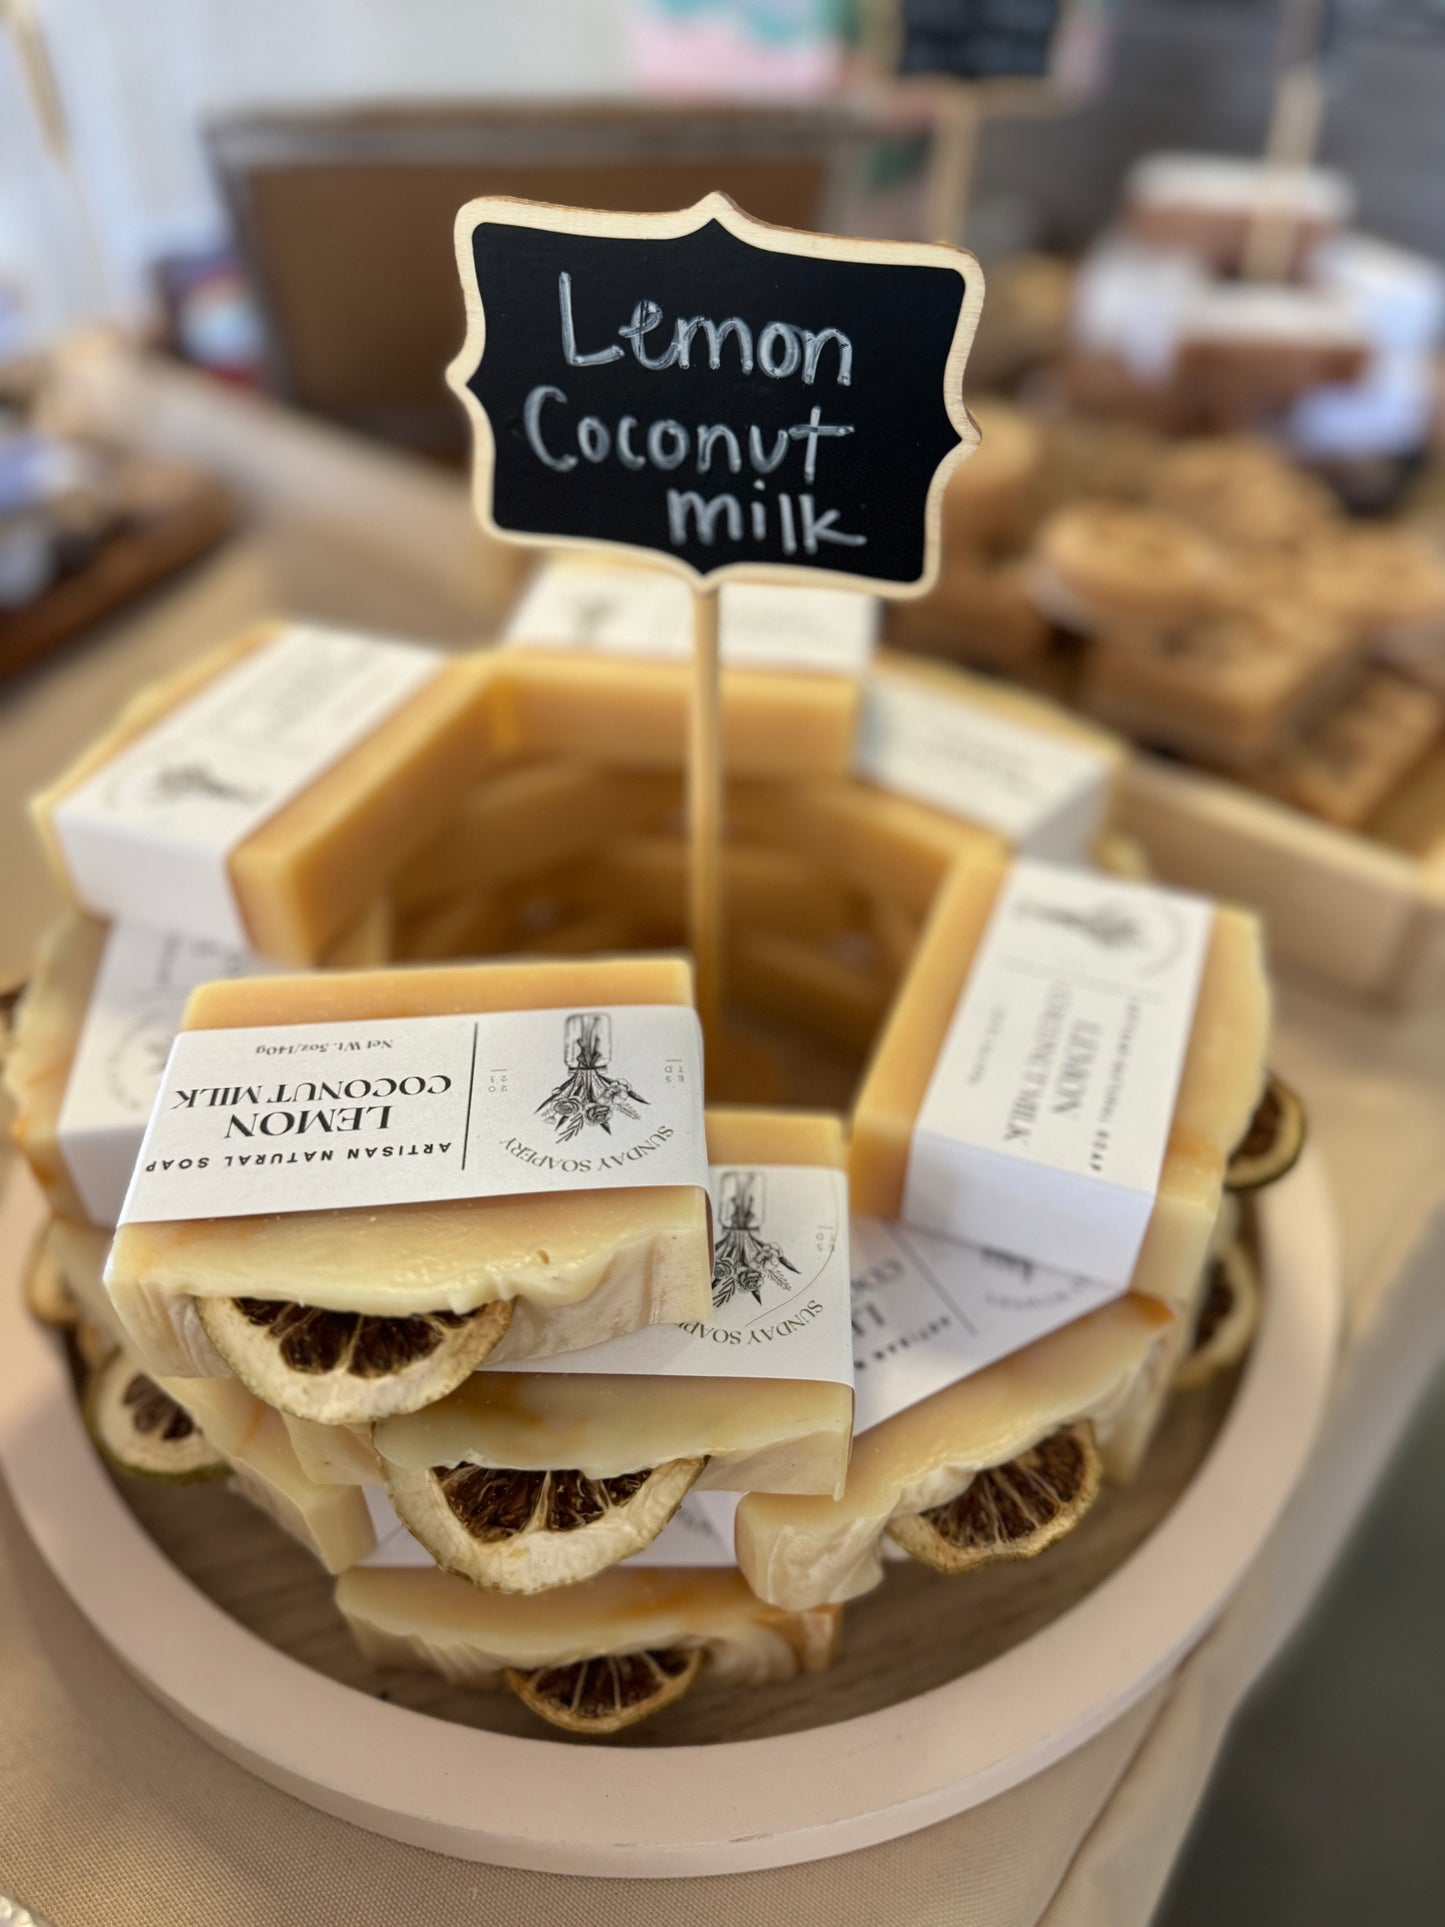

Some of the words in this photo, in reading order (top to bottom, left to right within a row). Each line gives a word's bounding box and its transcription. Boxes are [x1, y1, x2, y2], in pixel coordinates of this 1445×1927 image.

[559, 271, 853, 386] Lemon
[523, 385, 855, 483] Coconut
[666, 480, 868, 555] milk
[367, 1039, 394, 1049] Net
[168, 1084, 263, 1111] MILK
[266, 1074, 452, 1104] COCONUT
[223, 1105, 394, 1139] LEMON
[224, 1150, 334, 1167] NATURAL
[346, 1142, 452, 1160] ARTISAN
[499, 1136, 591, 1173] SOAPERY
[598, 1125, 674, 1171] SUNDAY
[145, 1157, 210, 1172] SOAP
[678, 1321, 742, 1345] SOAP
[747, 1299, 824, 1345] SUNDAY
